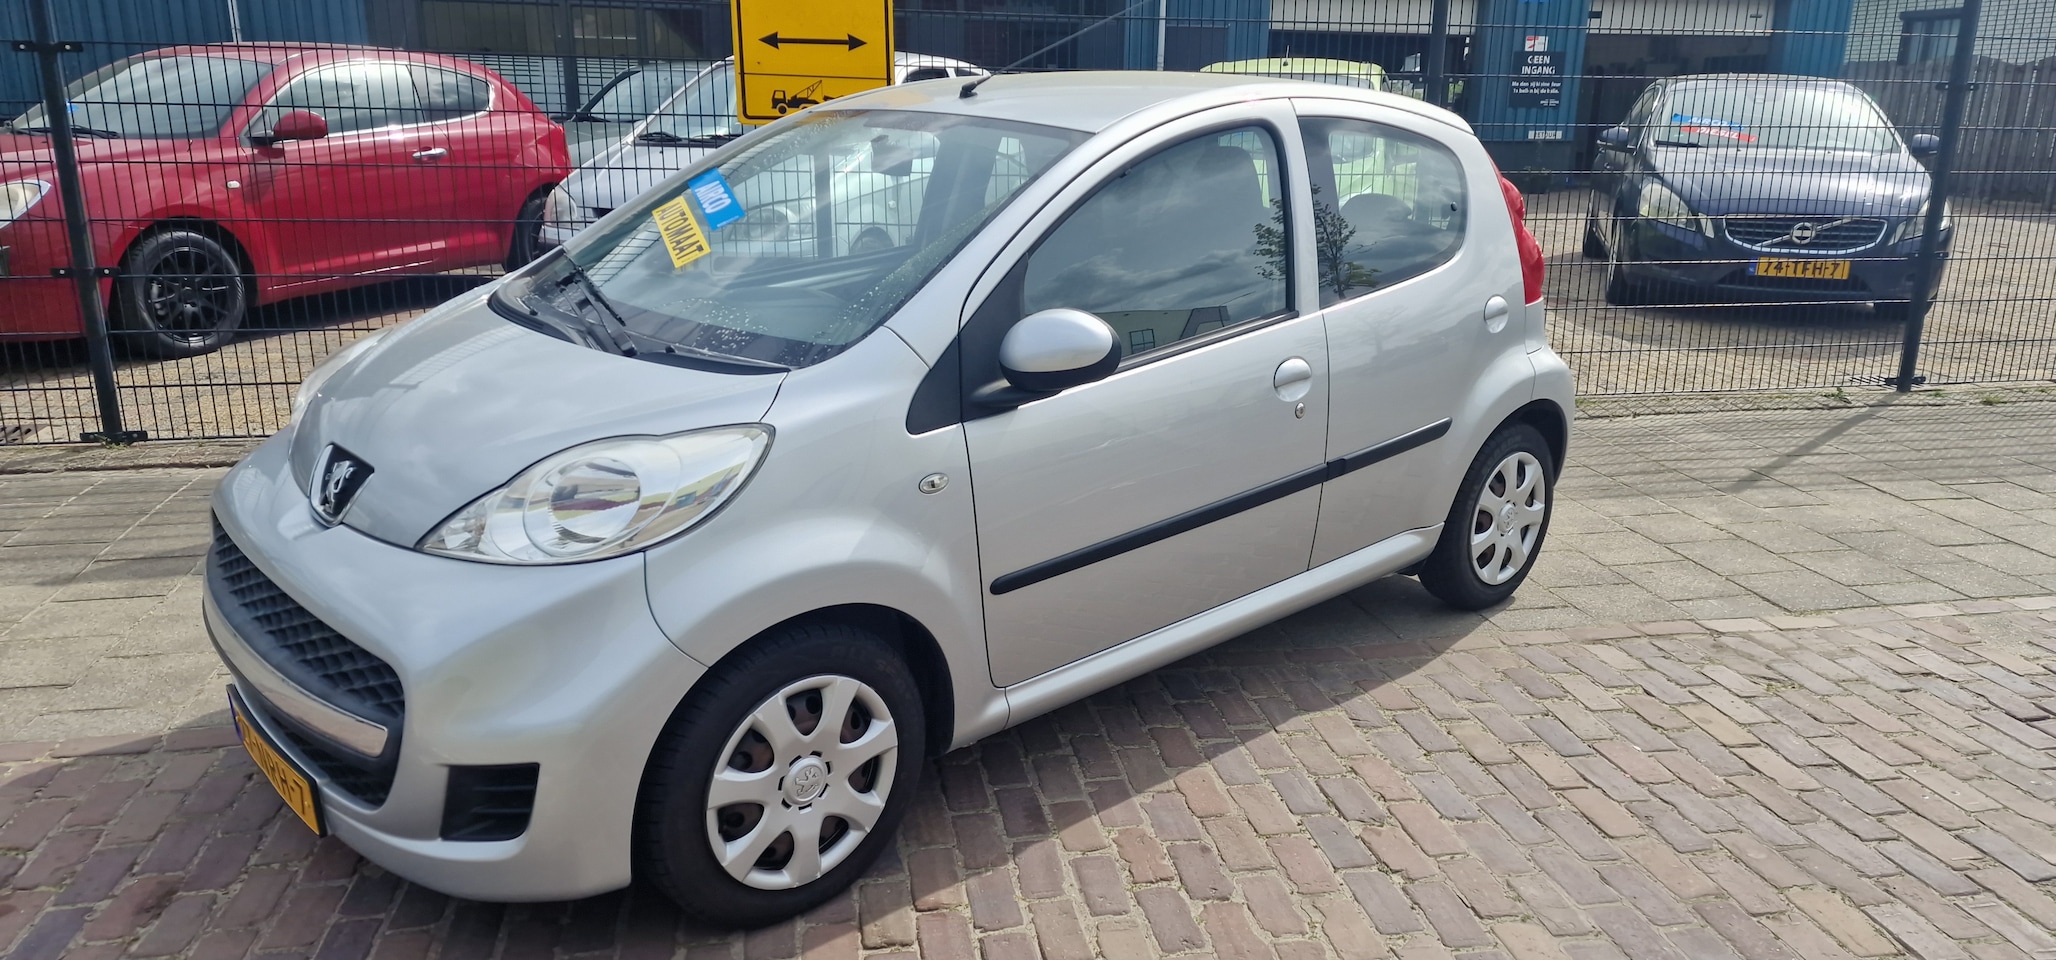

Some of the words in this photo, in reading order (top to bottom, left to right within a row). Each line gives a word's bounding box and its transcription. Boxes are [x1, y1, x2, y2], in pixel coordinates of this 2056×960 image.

[1527, 55, 1550, 64] GEEN
[1521, 65, 1556, 75] INGANG
[1697, 126, 1740, 139] DIESEL
[694, 180, 732, 214] AIRCO
[655, 201, 705, 261] AUTOMAAT
